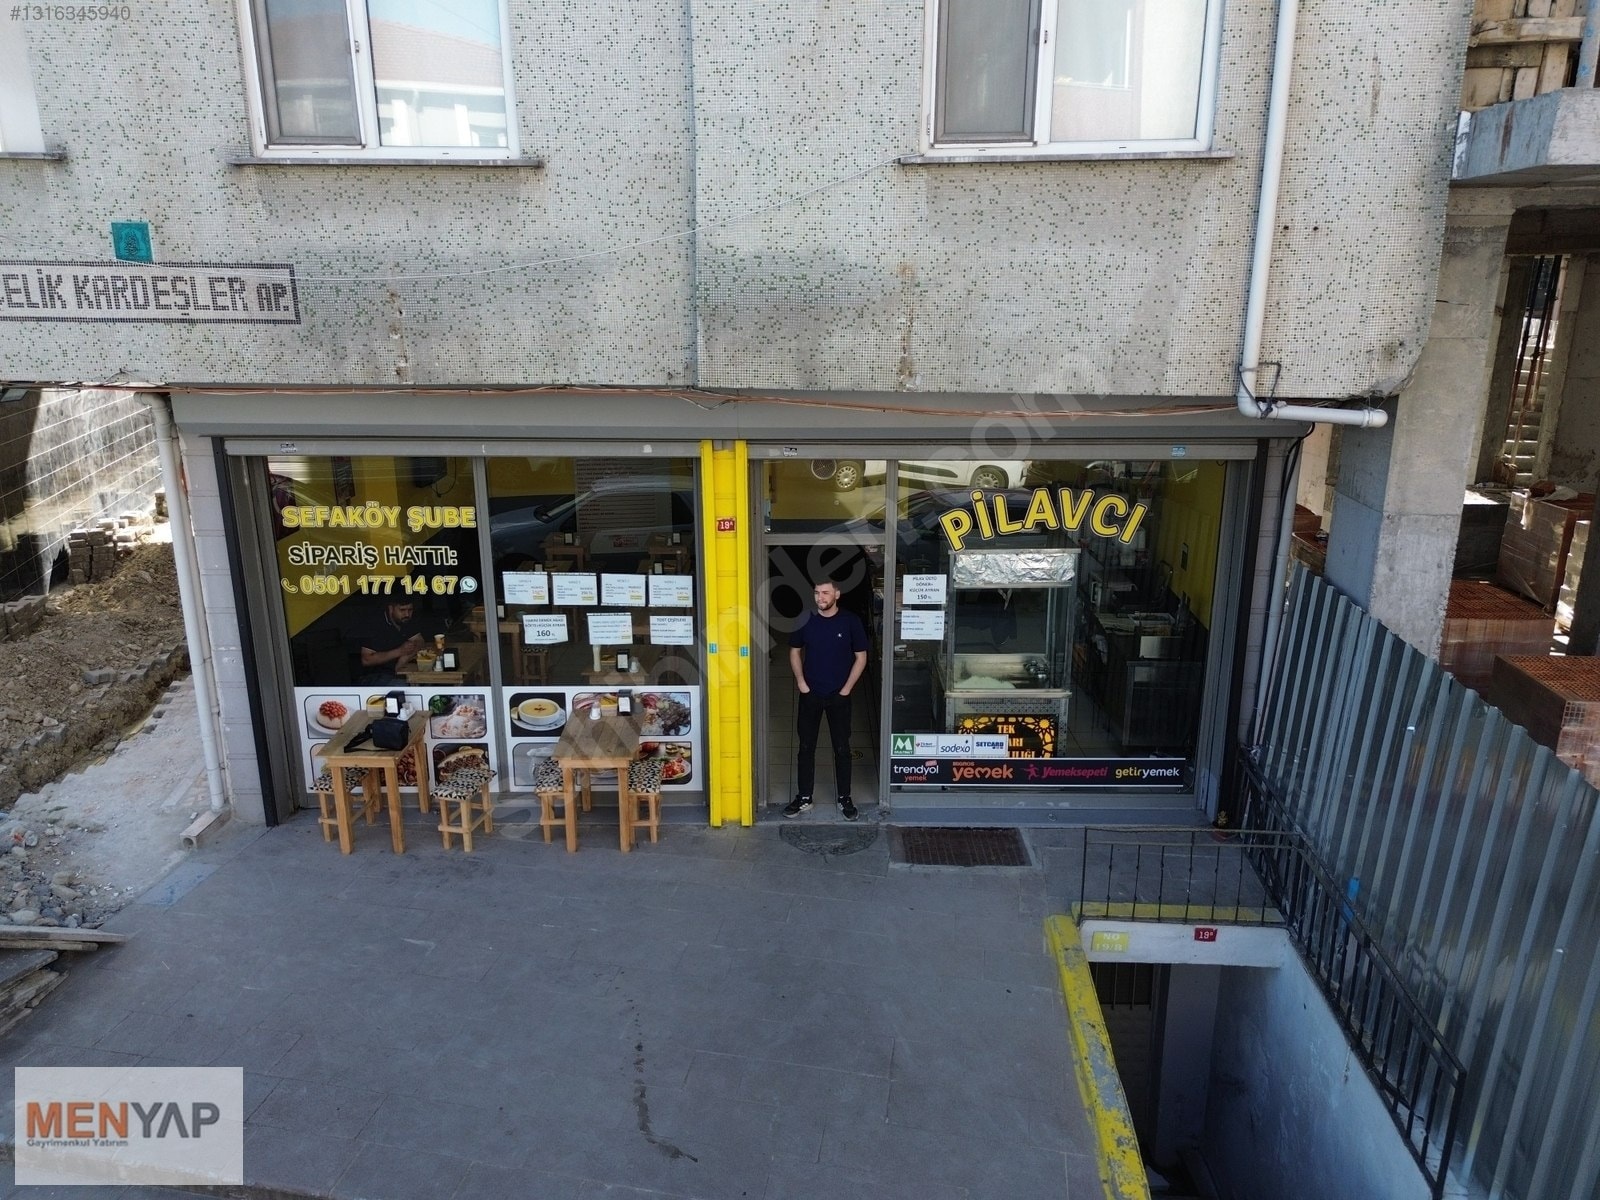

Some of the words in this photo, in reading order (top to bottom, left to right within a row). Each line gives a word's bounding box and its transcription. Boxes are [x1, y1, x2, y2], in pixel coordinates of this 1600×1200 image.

[72, 273, 249, 316] KARDEŞLER
[256, 282, 291, 312] AP.
[281, 501, 401, 528] SEFAKÖY
[407, 506, 477, 532] ŞUBE
[938, 487, 1149, 552] PİLAVCI
[288, 541, 379, 569] SİPARİŞ
[384, 545, 458, 566] HATTI:
[300, 575, 351, 595] 0501
[357, 575, 395, 595] 177
[400, 575, 428, 595] 14
[431, 575, 458, 595] 67
[536, 629, 551, 637] 160
[997, 724, 1015, 735] TEK
[940, 739, 971, 753] sodexo
[893, 764, 939, 776] trendyol
[952, 764, 1014, 782] yemek
[1115, 766, 1180, 779] getiryemek
[904, 774, 928, 783] yemek
